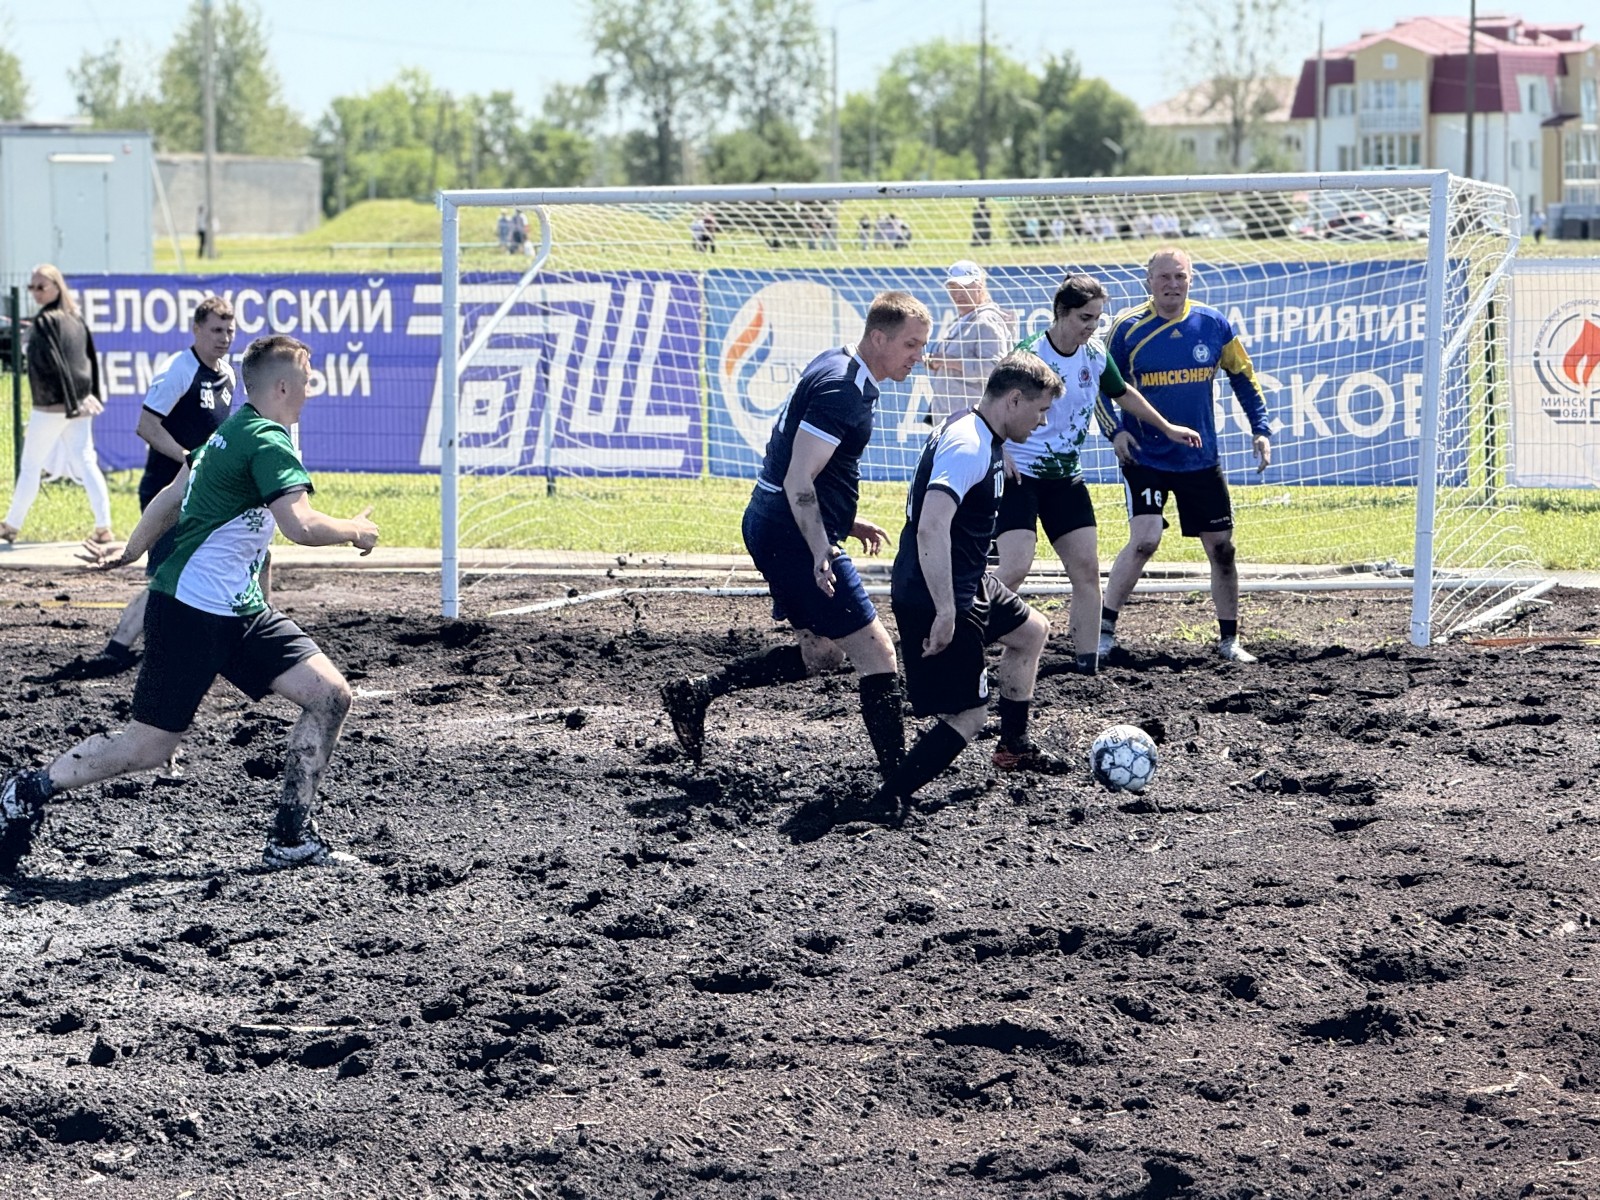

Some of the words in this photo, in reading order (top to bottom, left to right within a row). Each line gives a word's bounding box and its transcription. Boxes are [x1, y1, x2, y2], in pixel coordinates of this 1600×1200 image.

[200, 388, 215, 409] 99
[1541, 398, 1586, 407] МИНСК
[1563, 408, 1587, 418] ОБЛ
[1141, 487, 1163, 508] 16
